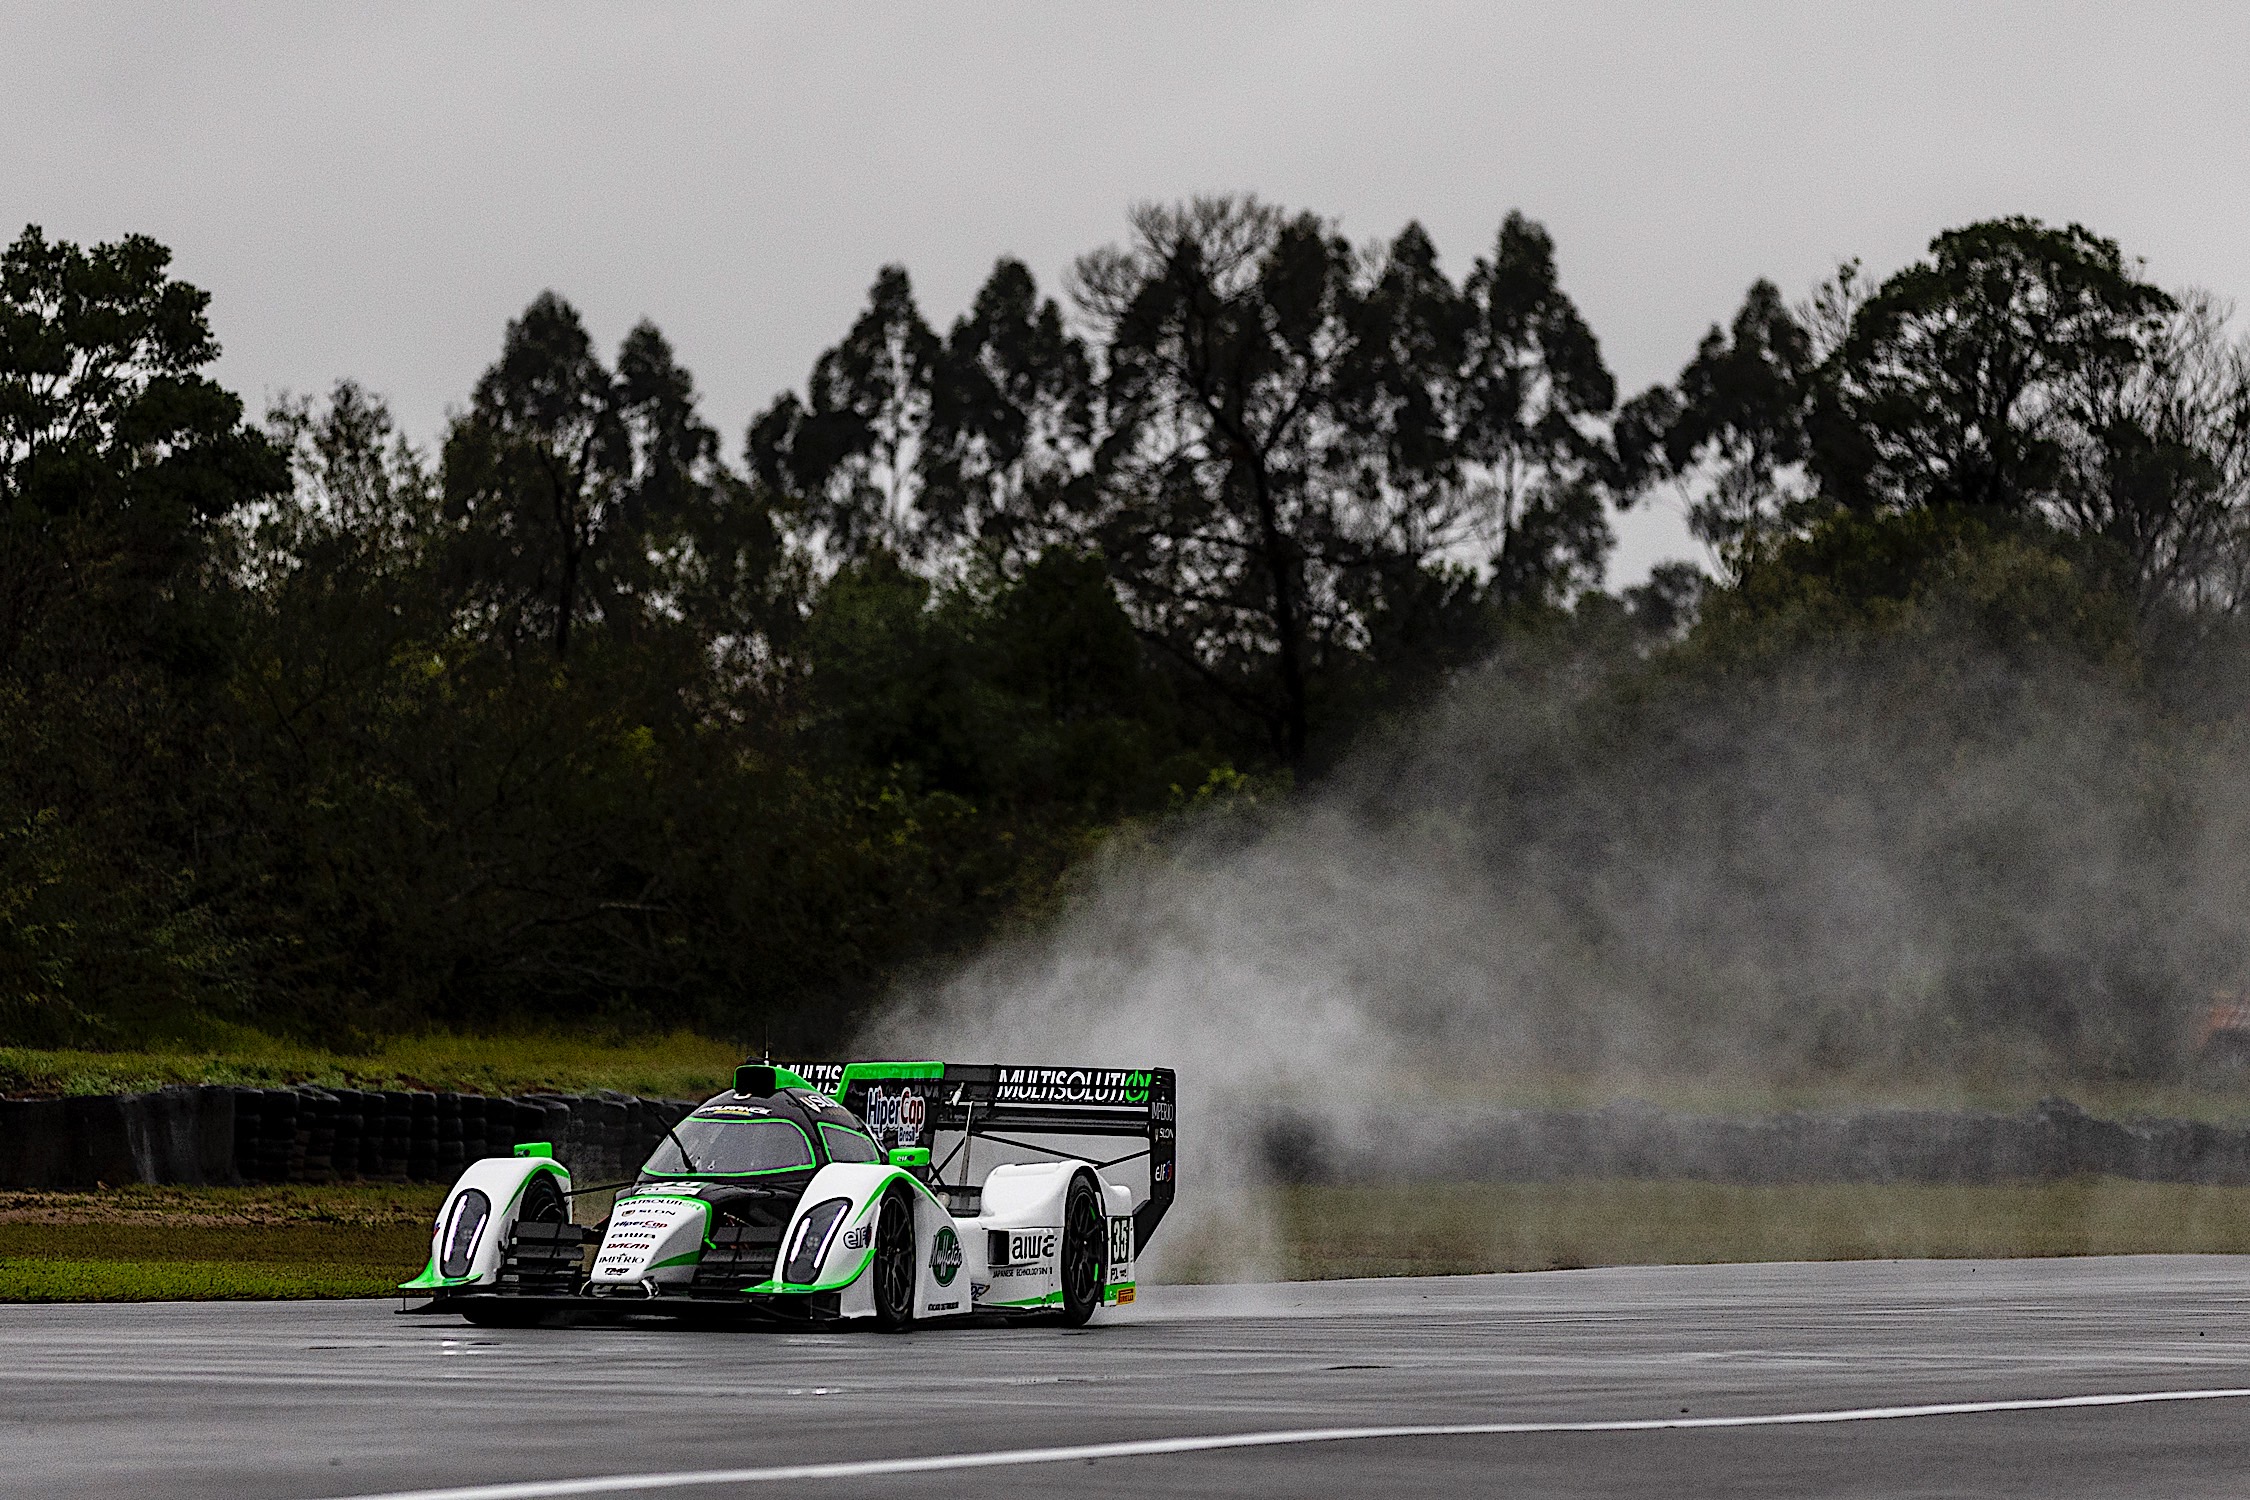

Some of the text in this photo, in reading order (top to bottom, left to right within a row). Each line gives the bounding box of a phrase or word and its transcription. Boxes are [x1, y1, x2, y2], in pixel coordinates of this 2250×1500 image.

[867, 1087, 924, 1134] HiperCap
[843, 1226, 867, 1249] elf
[1113, 1220, 1128, 1262] 35
